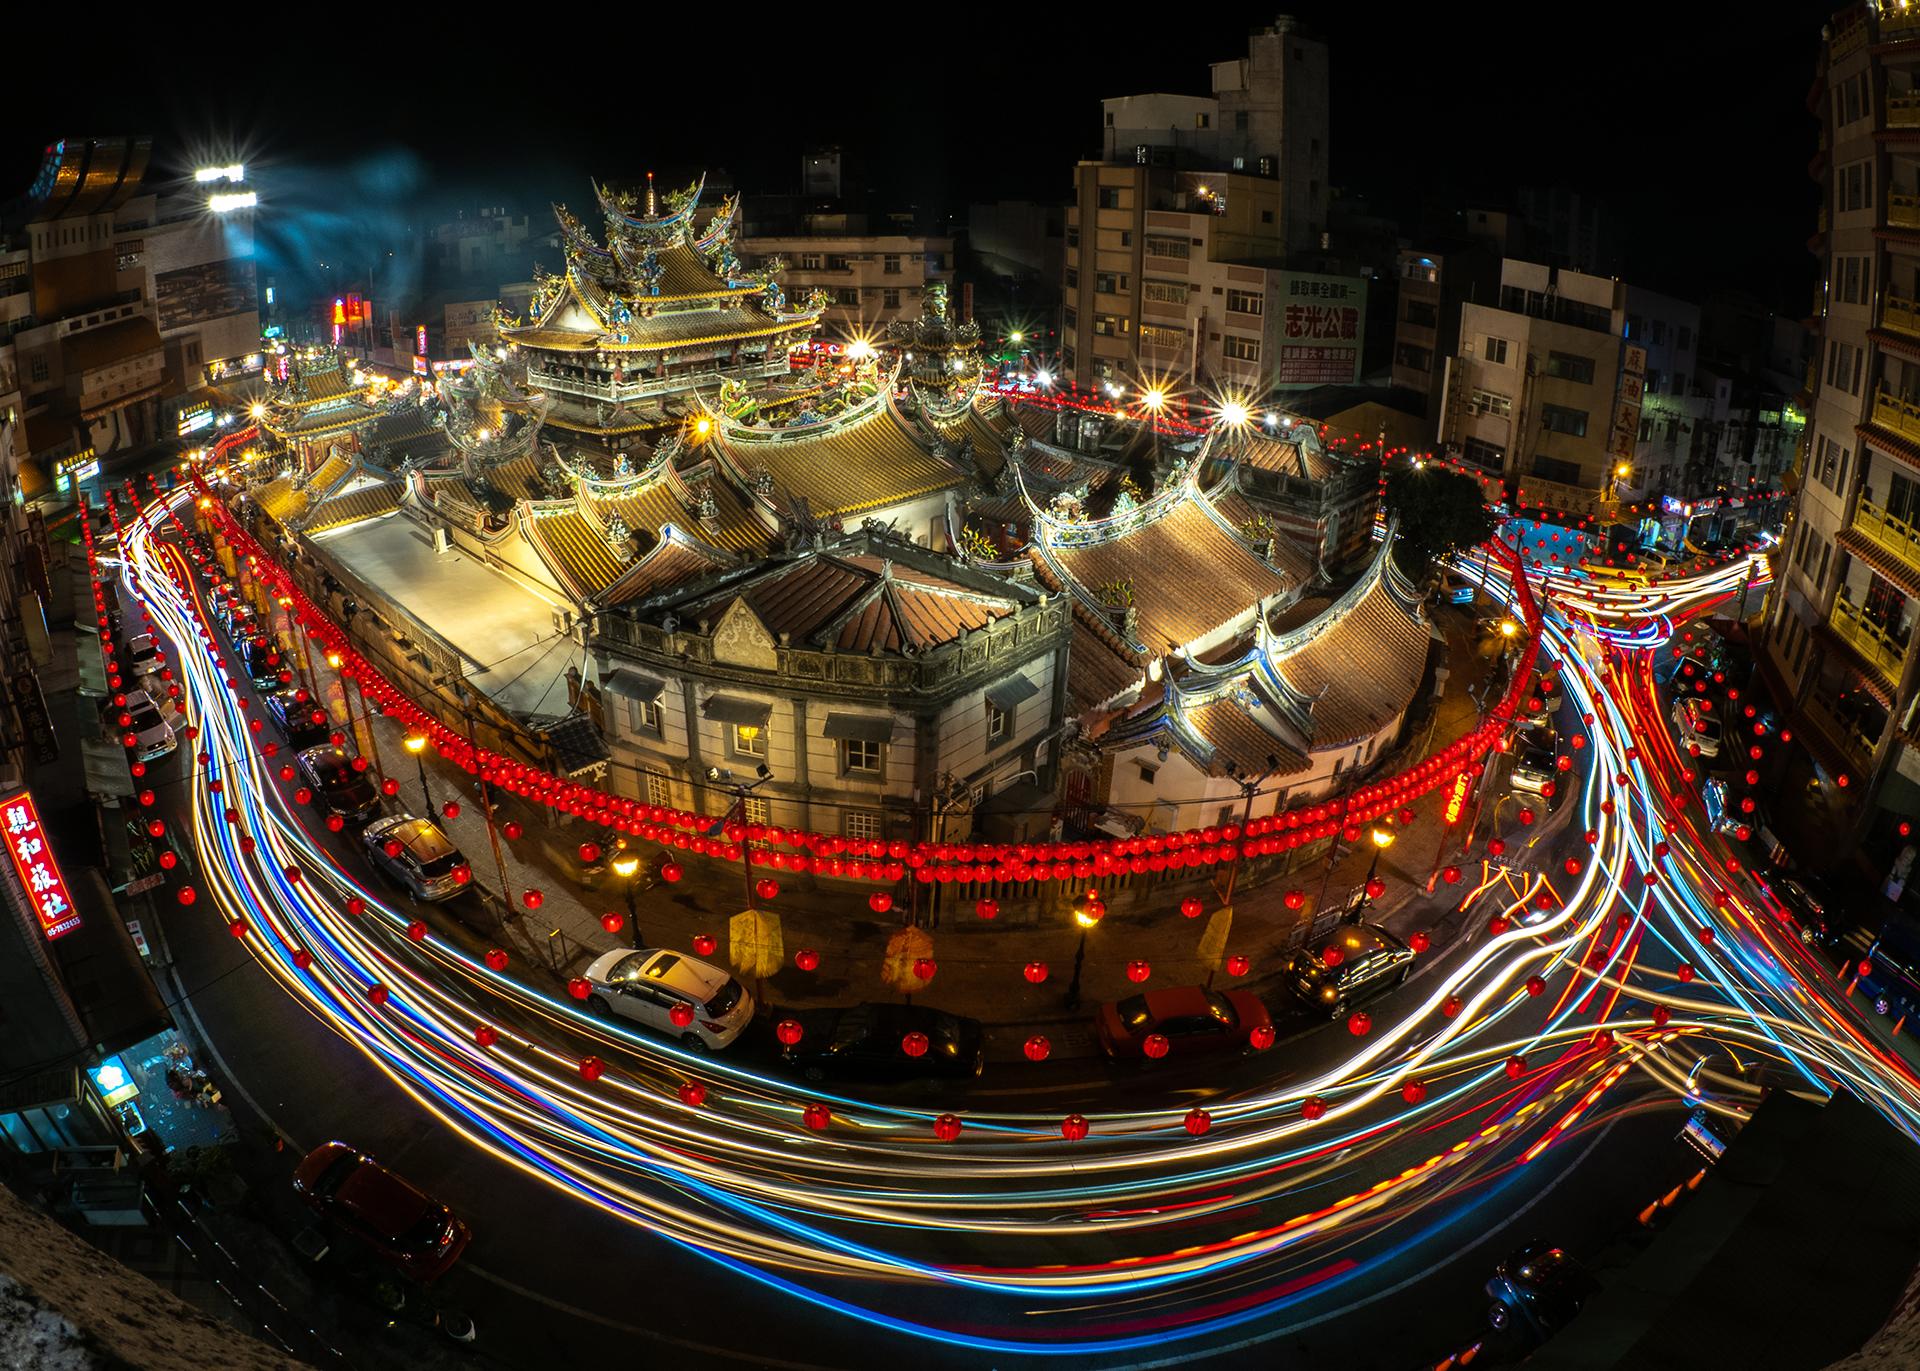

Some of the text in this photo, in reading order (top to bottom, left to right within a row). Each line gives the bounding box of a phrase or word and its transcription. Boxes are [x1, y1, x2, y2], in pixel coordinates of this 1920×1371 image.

[1285, 303, 1359, 339] 志光公職
[1615, 349, 1643, 458] 麻油大王
[6, 805, 68, 919] 親和旅社
